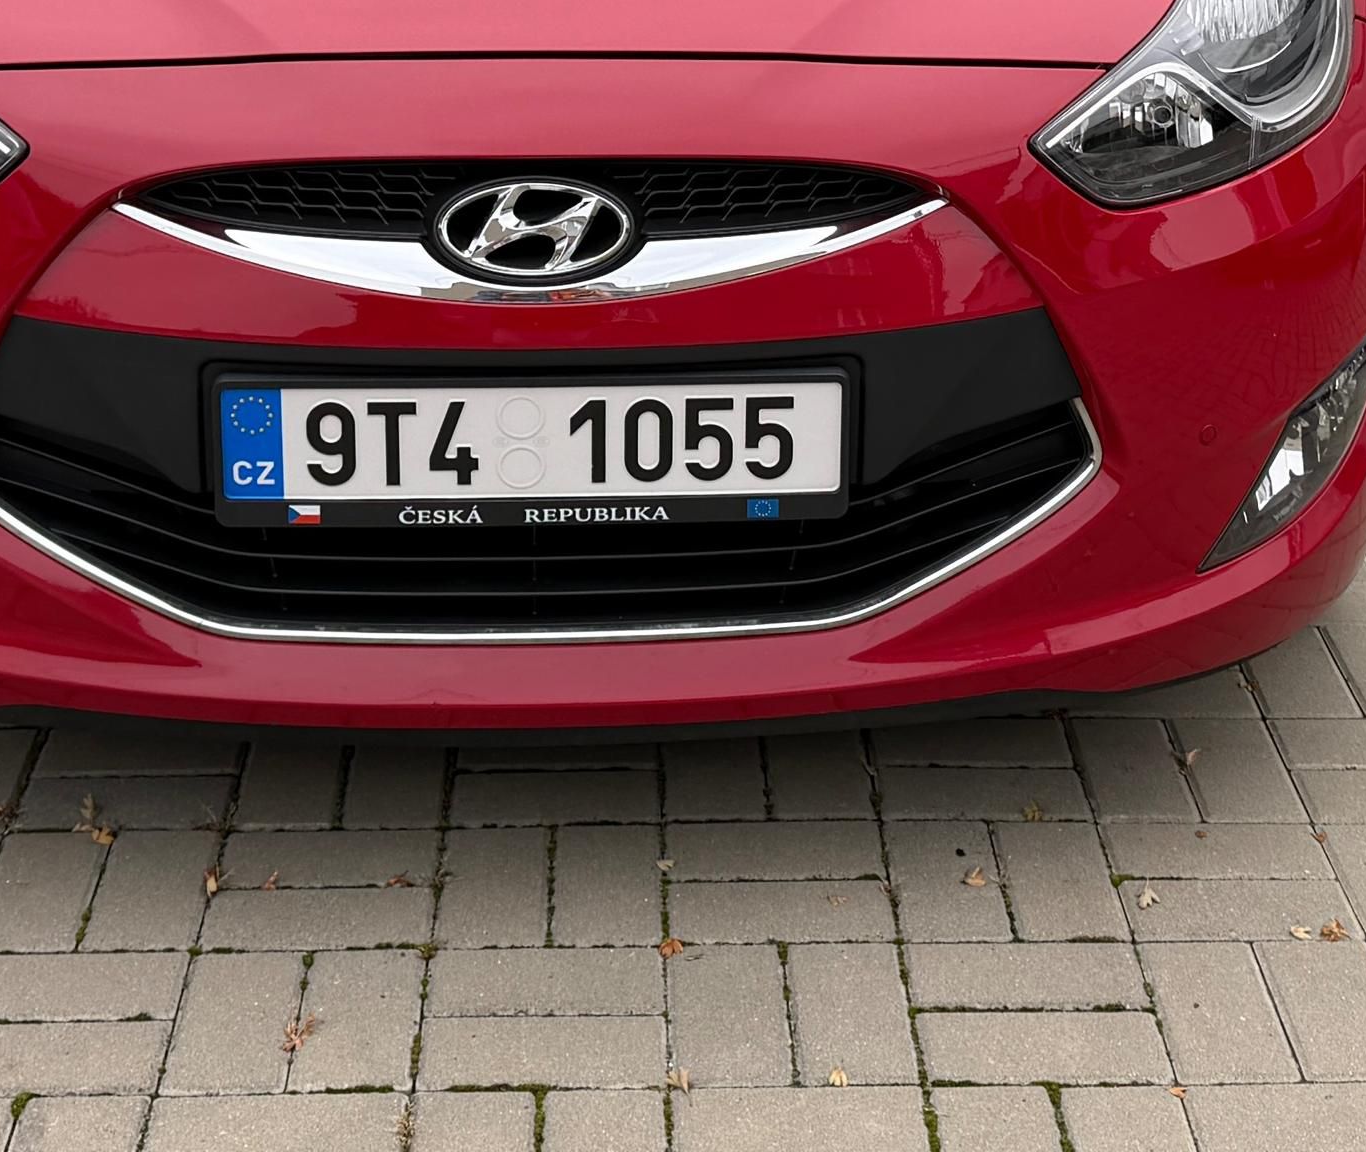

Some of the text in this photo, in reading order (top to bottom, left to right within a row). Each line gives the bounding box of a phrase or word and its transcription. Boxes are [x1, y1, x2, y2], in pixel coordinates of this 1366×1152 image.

[305, 395, 796, 487] 9T4 1055
[232, 460, 276, 486] CZ
[398, 505, 670, 525] ČESKÁ REPUBLIKA
